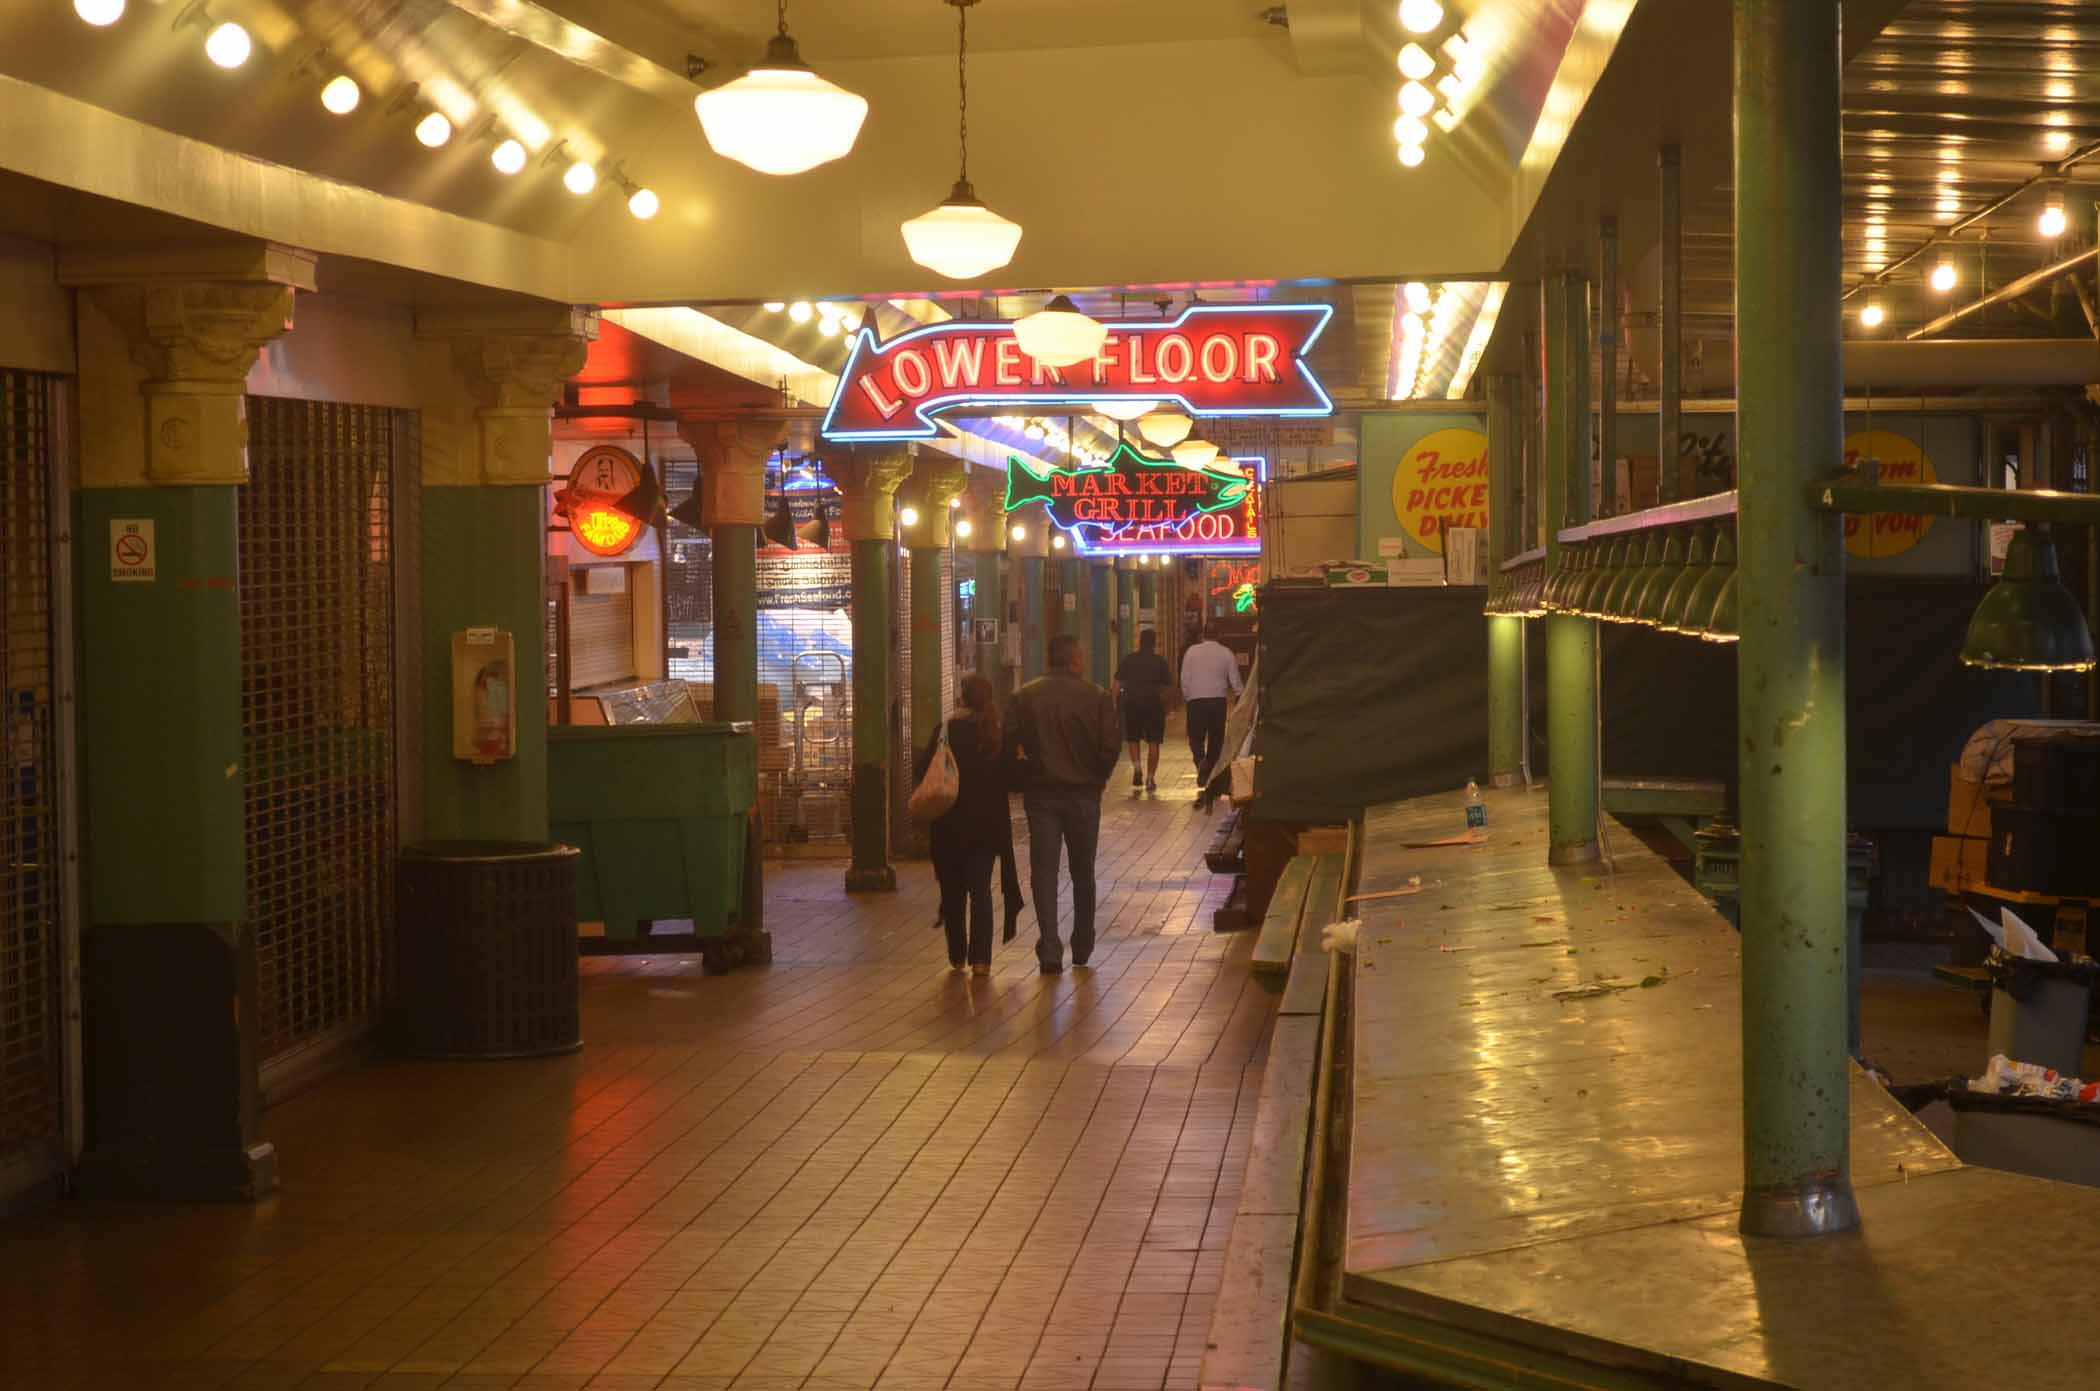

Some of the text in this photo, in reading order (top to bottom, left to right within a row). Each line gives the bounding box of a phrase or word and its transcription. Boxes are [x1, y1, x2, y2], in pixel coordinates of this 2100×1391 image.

[1093, 334, 1281, 386] FLOOR
[1415, 448, 1488, 484] Fresh
[1050, 471, 1209, 497] MARKET
[1073, 497, 1187, 521] GRILL
[1405, 485, 1488, 511] PICKE
[1822, 487, 1834, 508] 4
[126, 524, 139, 534] NO
[1100, 514, 1235, 541] SEAFOOD
[112, 567, 154, 578] SMOKING
